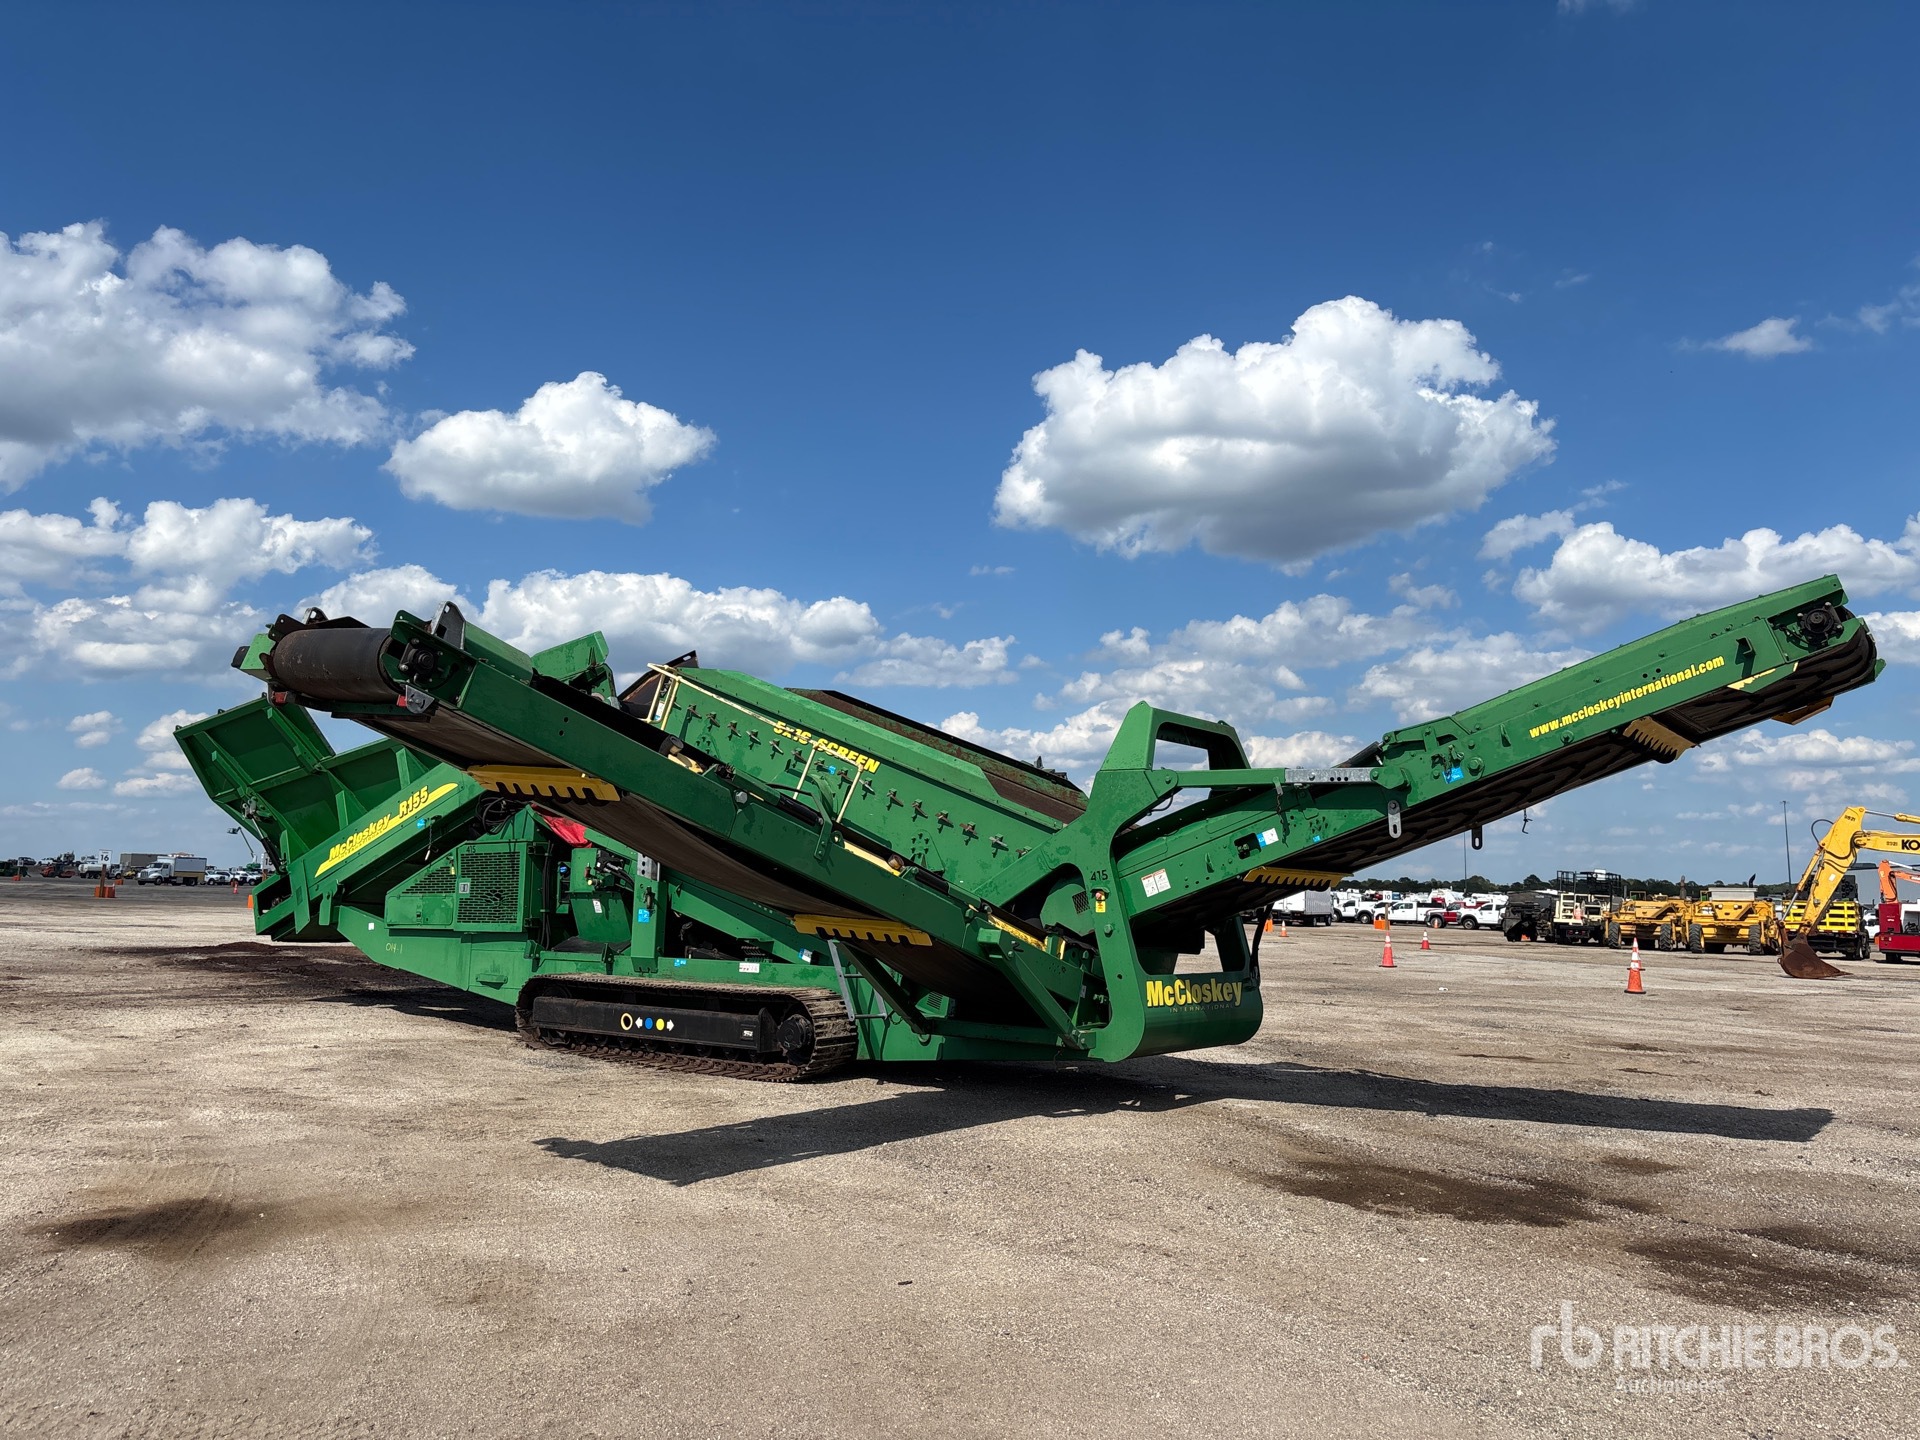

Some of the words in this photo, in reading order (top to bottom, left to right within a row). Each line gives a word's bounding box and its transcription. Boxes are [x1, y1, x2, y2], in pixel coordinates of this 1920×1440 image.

[1528, 655, 1725, 739] www.mccloskeyinternational.com
[816, 738, 881, 773] SCREEN
[329, 814, 391, 862] McCloskey
[399, 785, 429, 818] R155
[1901, 839, 1920, 851] KO
[1090, 869, 1109, 881] 415
[1146, 978, 1242, 1007] McCloskey
[1169, 1004, 1234, 1013] INTERNATIONAL
